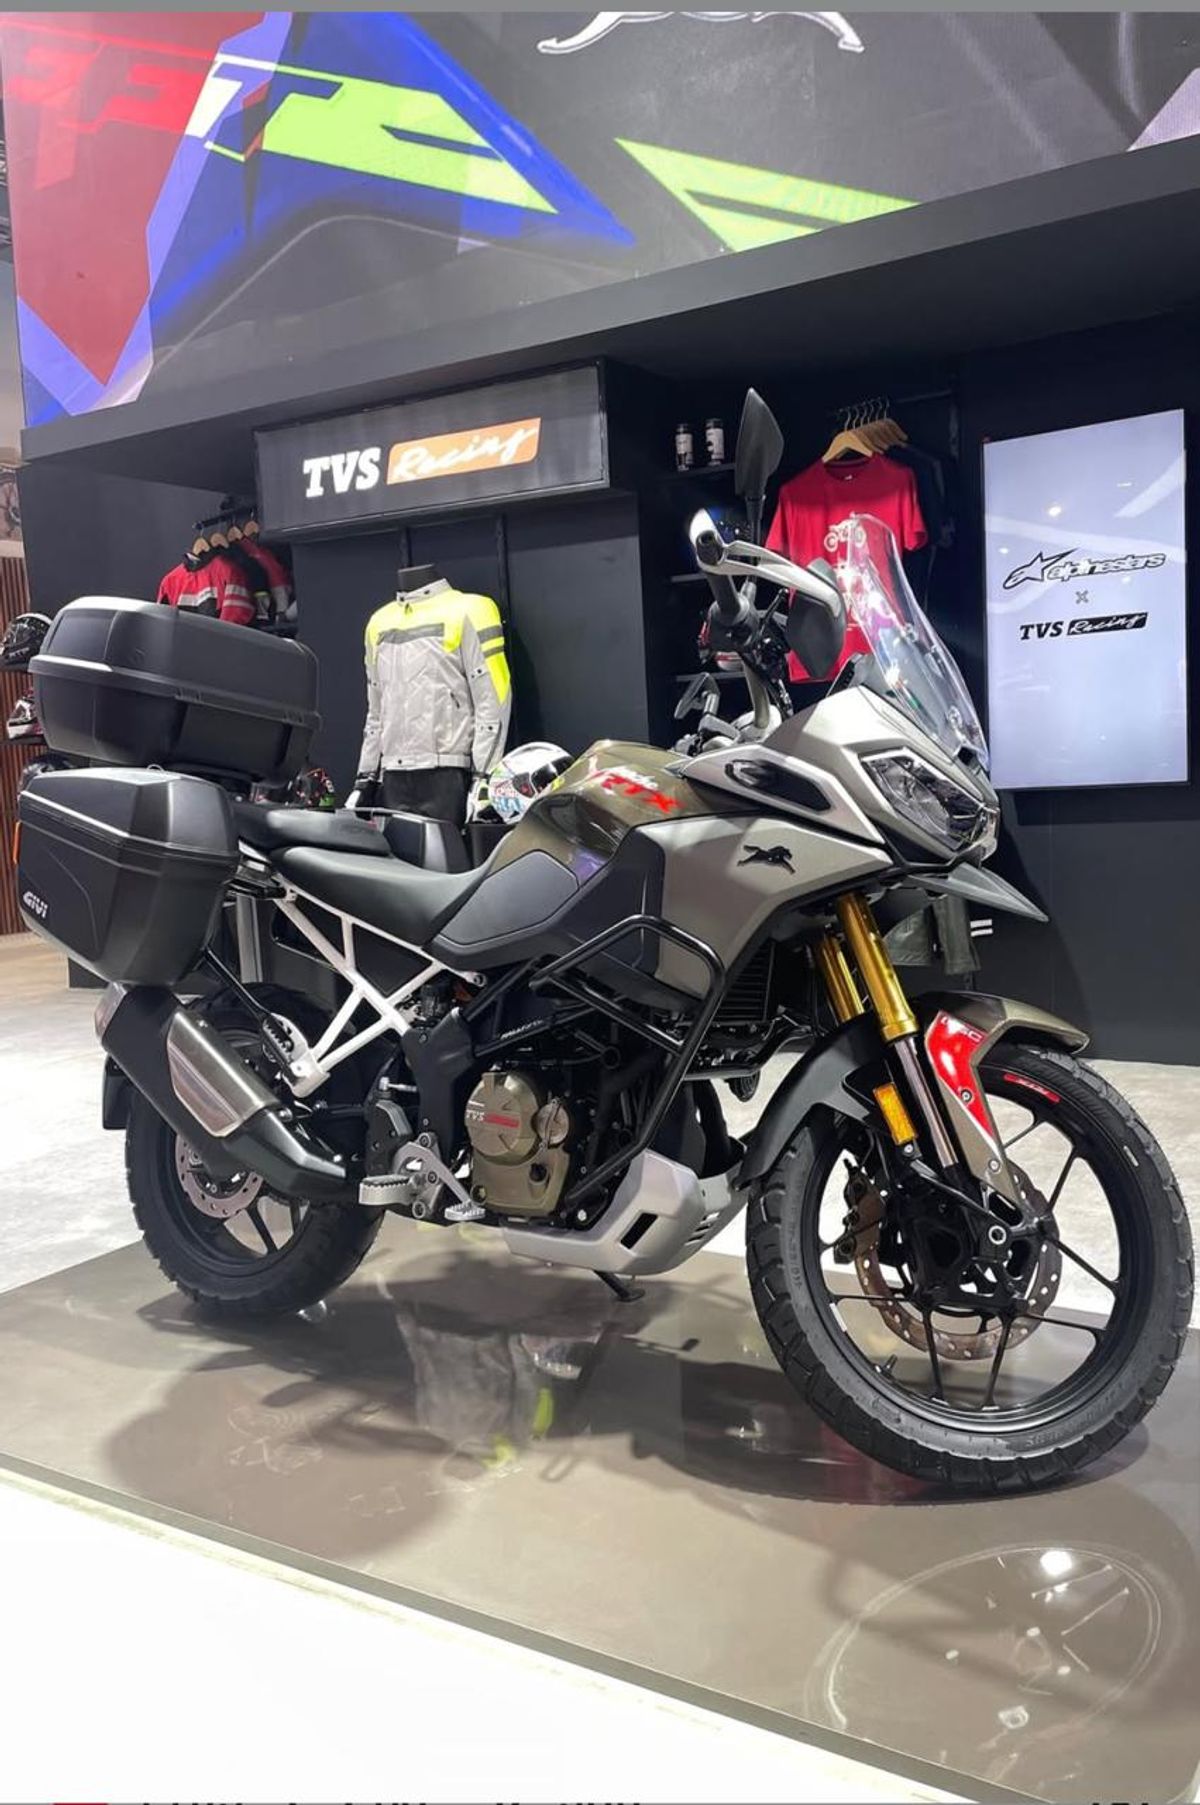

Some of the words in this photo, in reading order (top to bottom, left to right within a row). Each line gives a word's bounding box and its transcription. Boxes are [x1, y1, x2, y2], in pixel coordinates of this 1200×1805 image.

[303, 447, 381, 498] TVS
[393, 427, 539, 481] Racing
[1047, 554, 1166, 582] alpinestars
[1020, 621, 1064, 640] TVS
[1069, 613, 1146, 635] Racing
